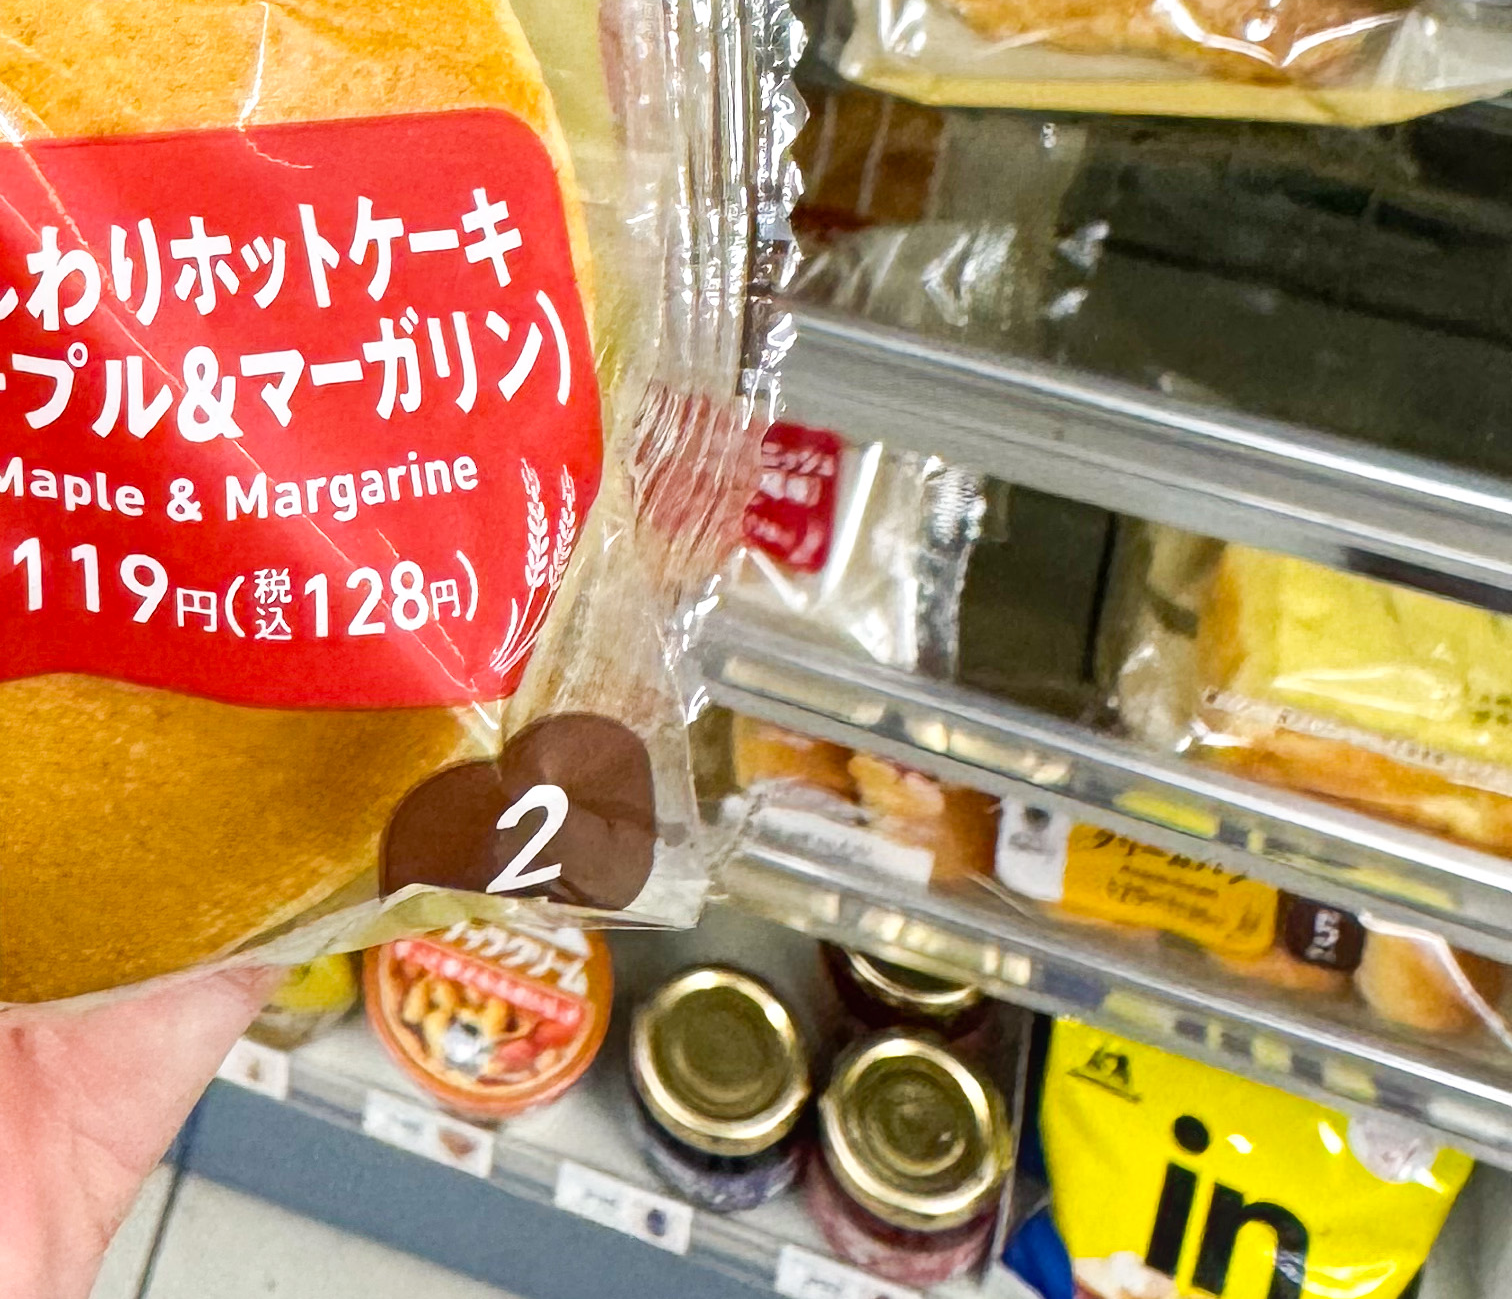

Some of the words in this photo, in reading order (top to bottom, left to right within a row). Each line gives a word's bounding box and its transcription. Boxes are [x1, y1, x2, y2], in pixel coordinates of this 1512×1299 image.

[167, 477, 203, 522] &
[225, 456, 479, 522] Margarine
[486, 783, 570, 894] 2
[1313, 908, 1341, 948] 5
[1144, 1113, 1310, 1299] in
